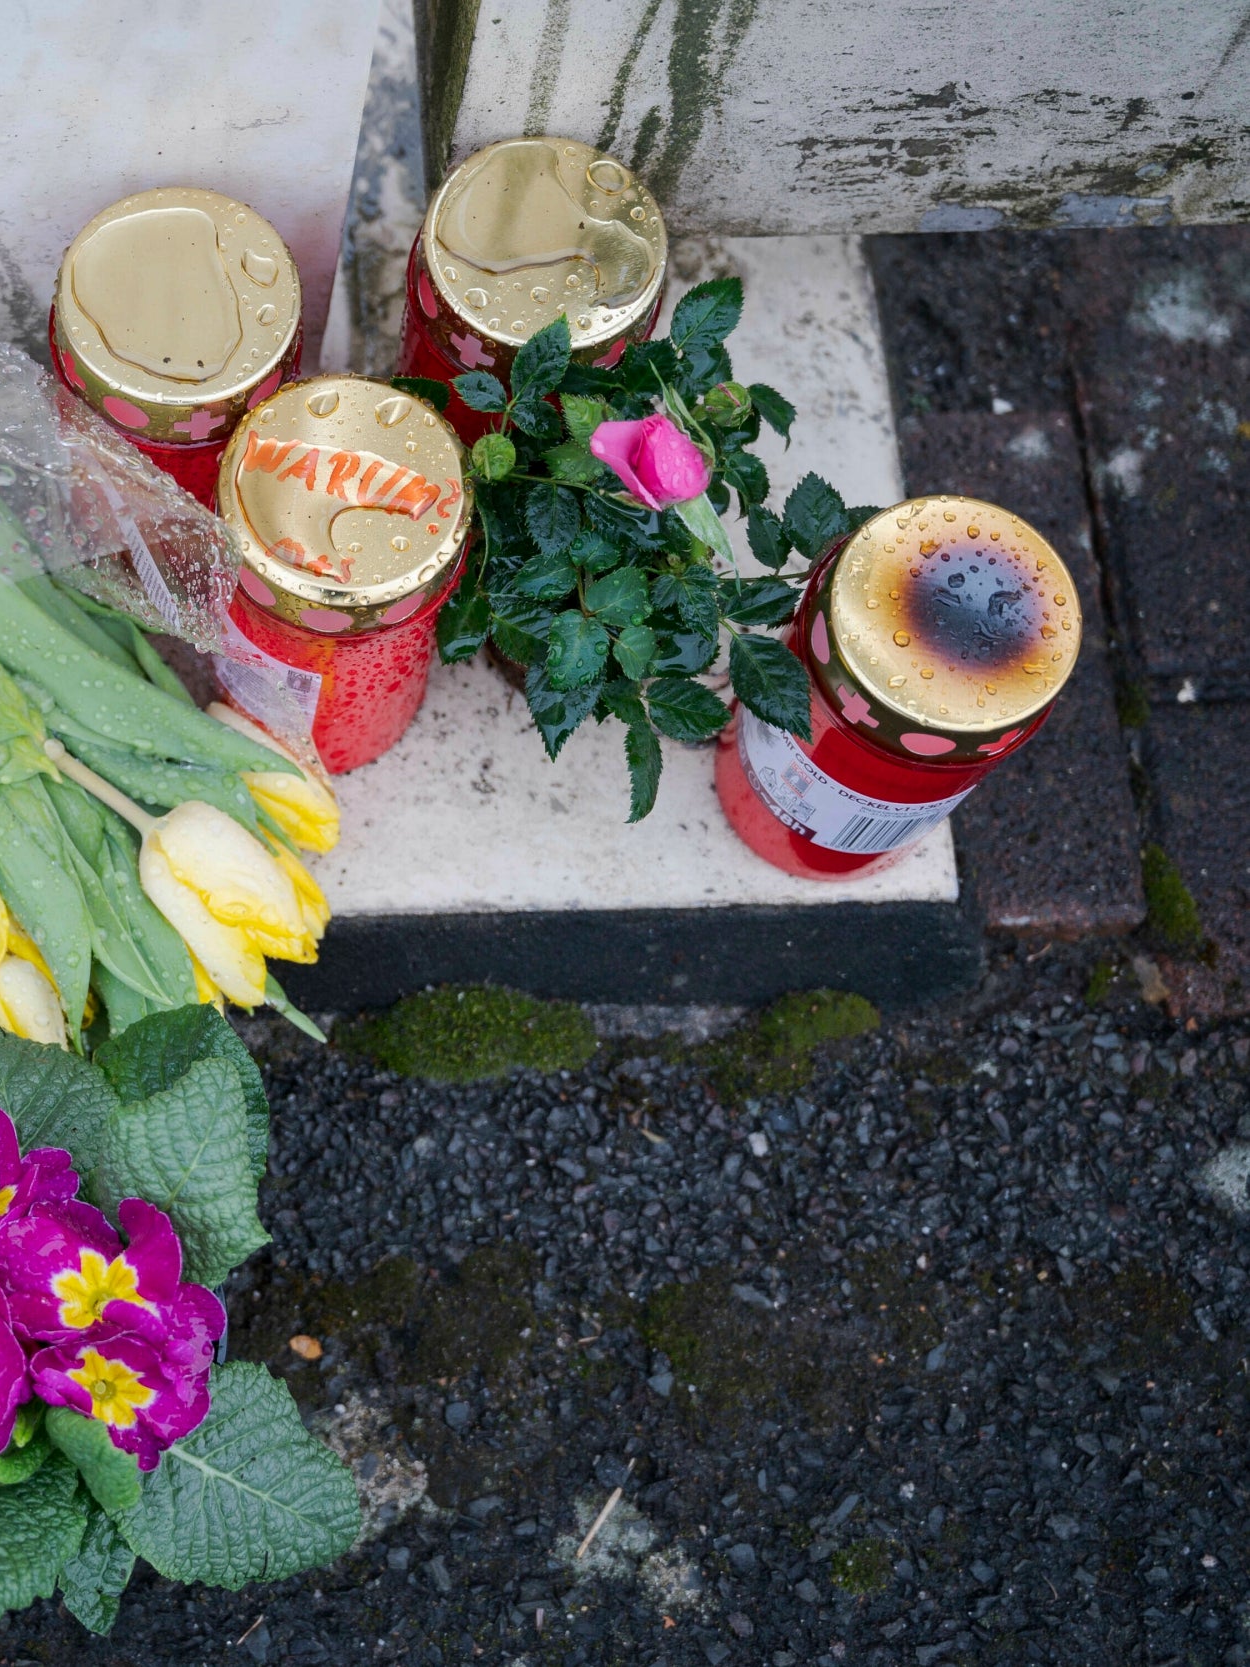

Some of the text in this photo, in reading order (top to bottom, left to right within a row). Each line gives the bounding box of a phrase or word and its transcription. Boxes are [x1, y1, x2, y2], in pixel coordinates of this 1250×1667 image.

[244, 430, 461, 535] WARUM?
[795, 753, 828, 785] GOLD
[838, 789, 891, 811] DECKEL
